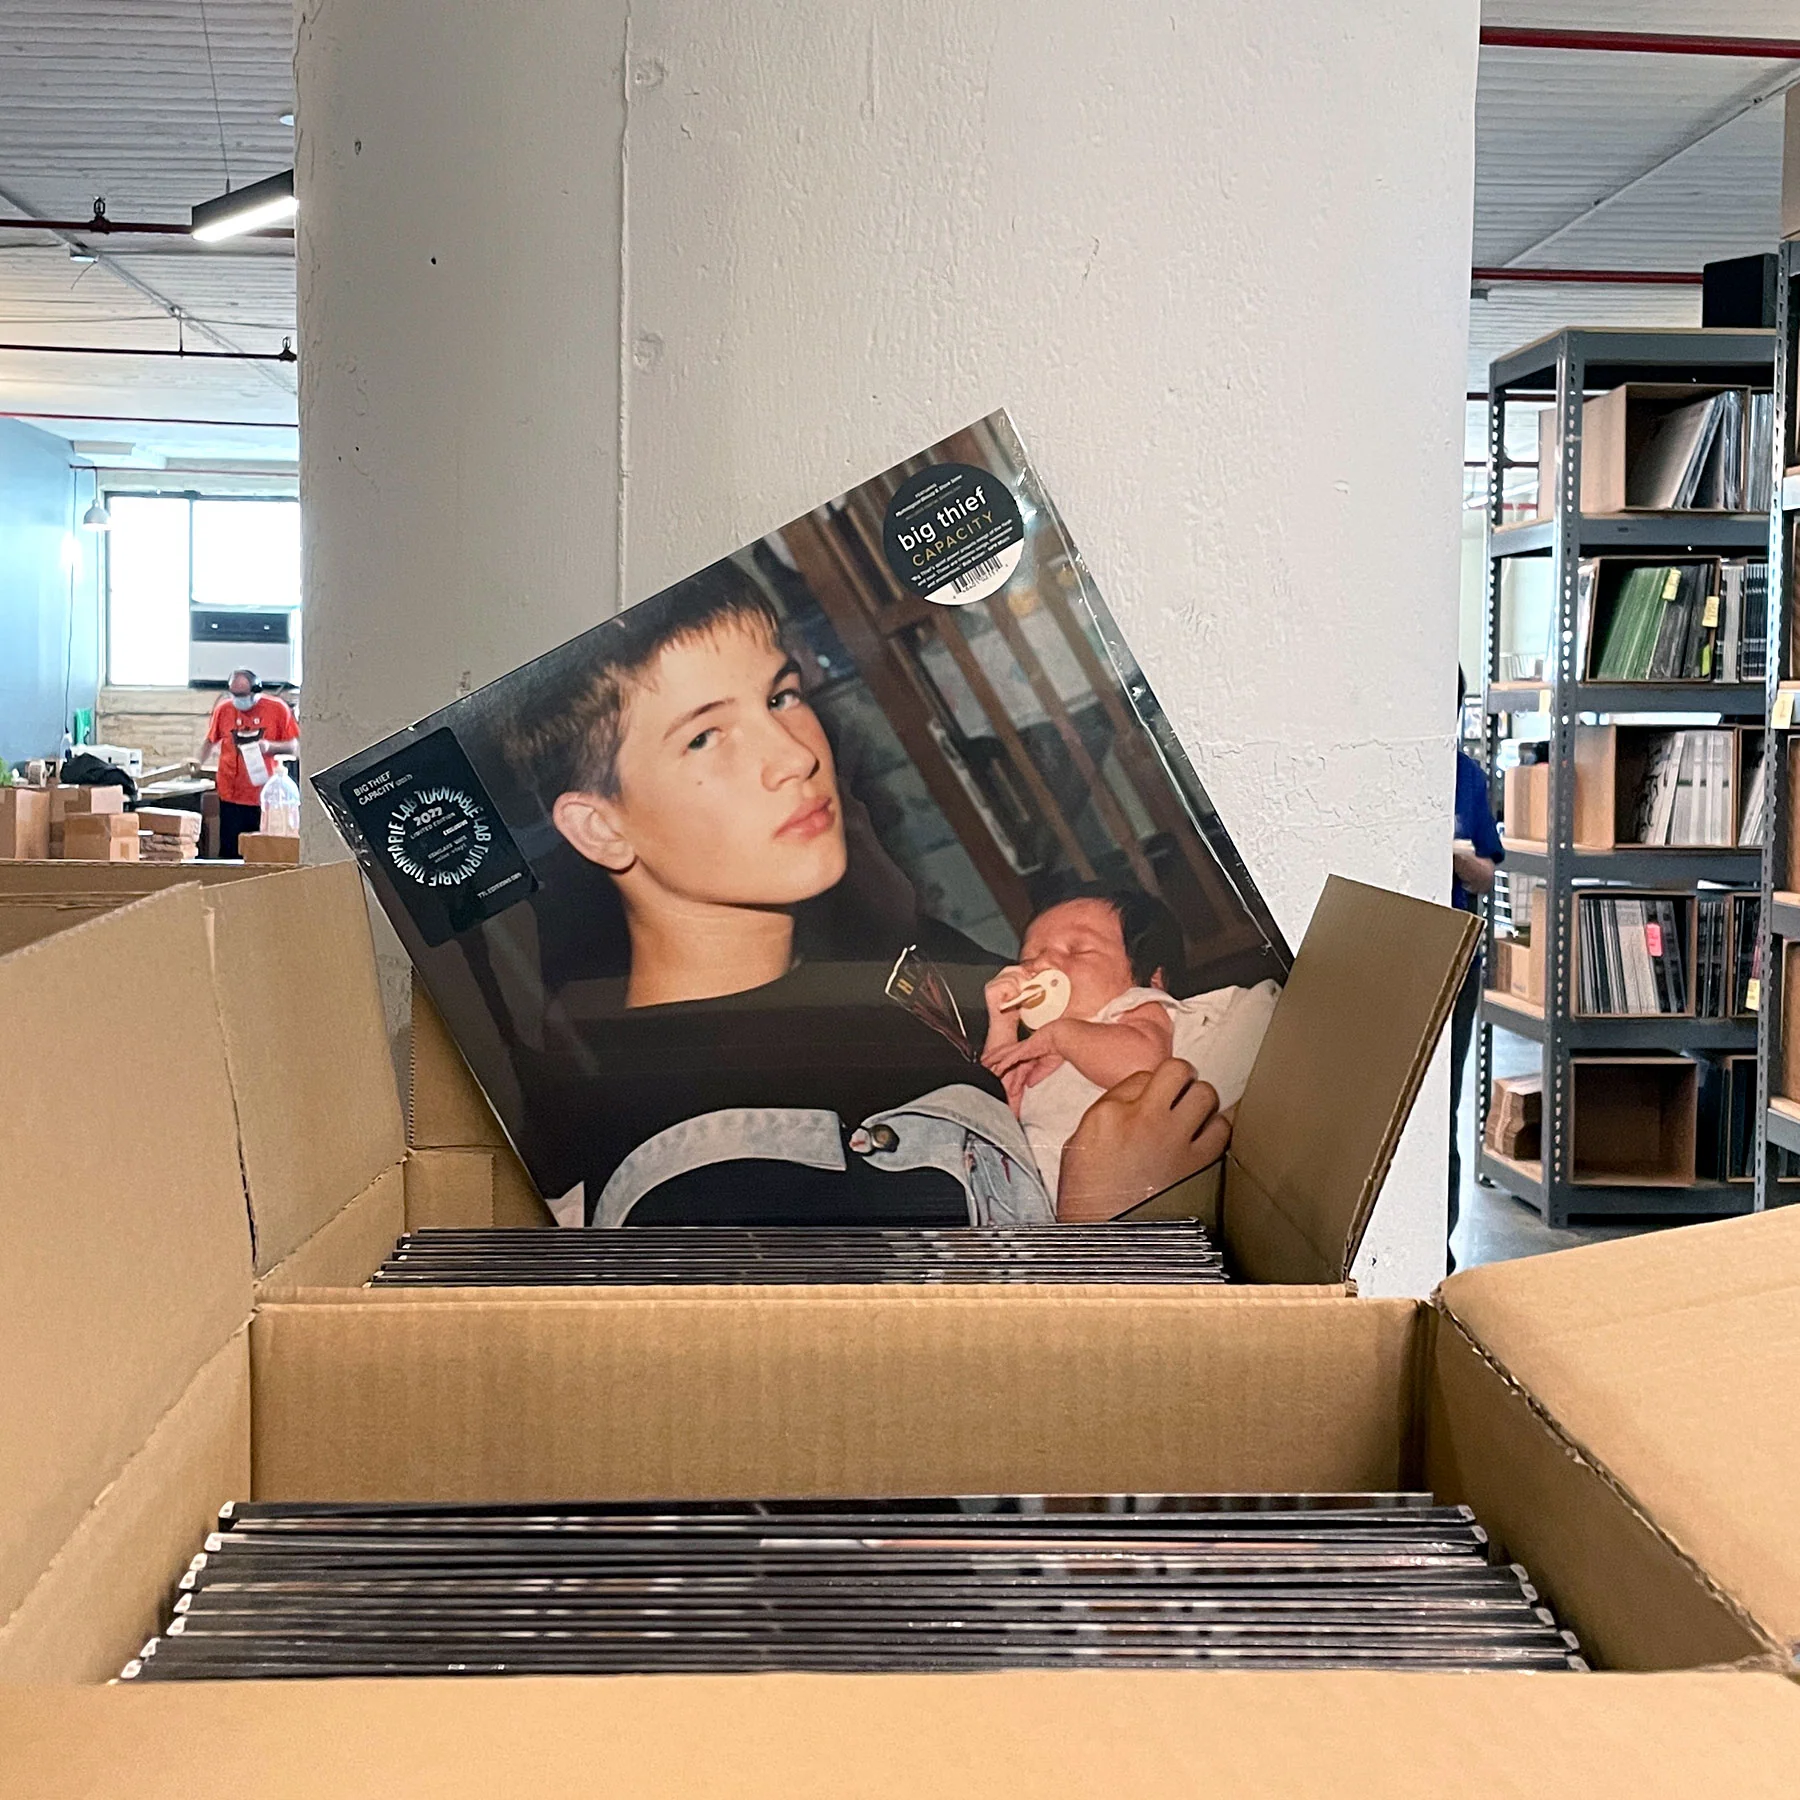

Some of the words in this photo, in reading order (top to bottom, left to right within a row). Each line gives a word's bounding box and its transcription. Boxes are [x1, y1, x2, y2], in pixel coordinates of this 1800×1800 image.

[898, 522, 936, 551] big
[937, 486, 987, 527] thief
[912, 510, 993, 566] CAPACITY
[353, 784, 369, 796] BIG
[368, 771, 392, 788] THIEF
[358, 781, 396, 806] CAPACITY
[413, 804, 444, 828] 2022
